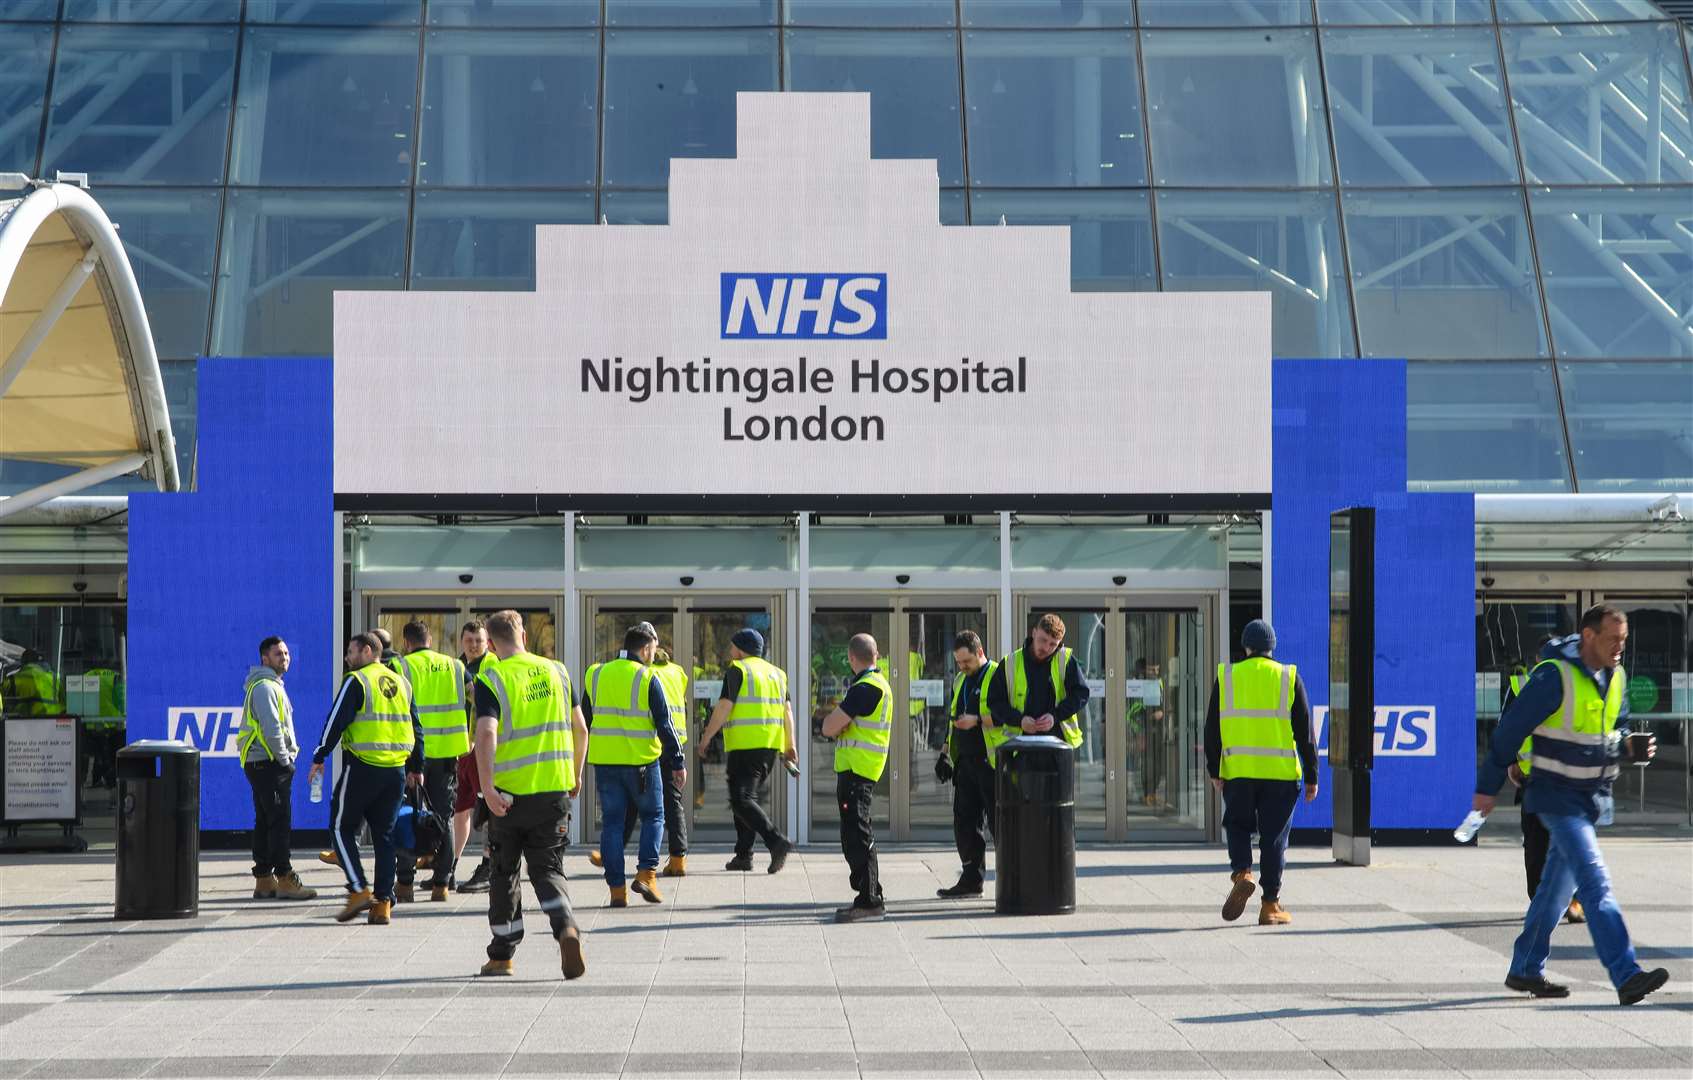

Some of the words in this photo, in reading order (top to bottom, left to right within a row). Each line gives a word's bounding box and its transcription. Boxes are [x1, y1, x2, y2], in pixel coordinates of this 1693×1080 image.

[725, 277, 881, 335] NHS
[581, 356, 834, 403] Nightingale
[850, 356, 1027, 403] Hospital
[723, 404, 885, 441] London
[175, 712, 240, 752] NH
